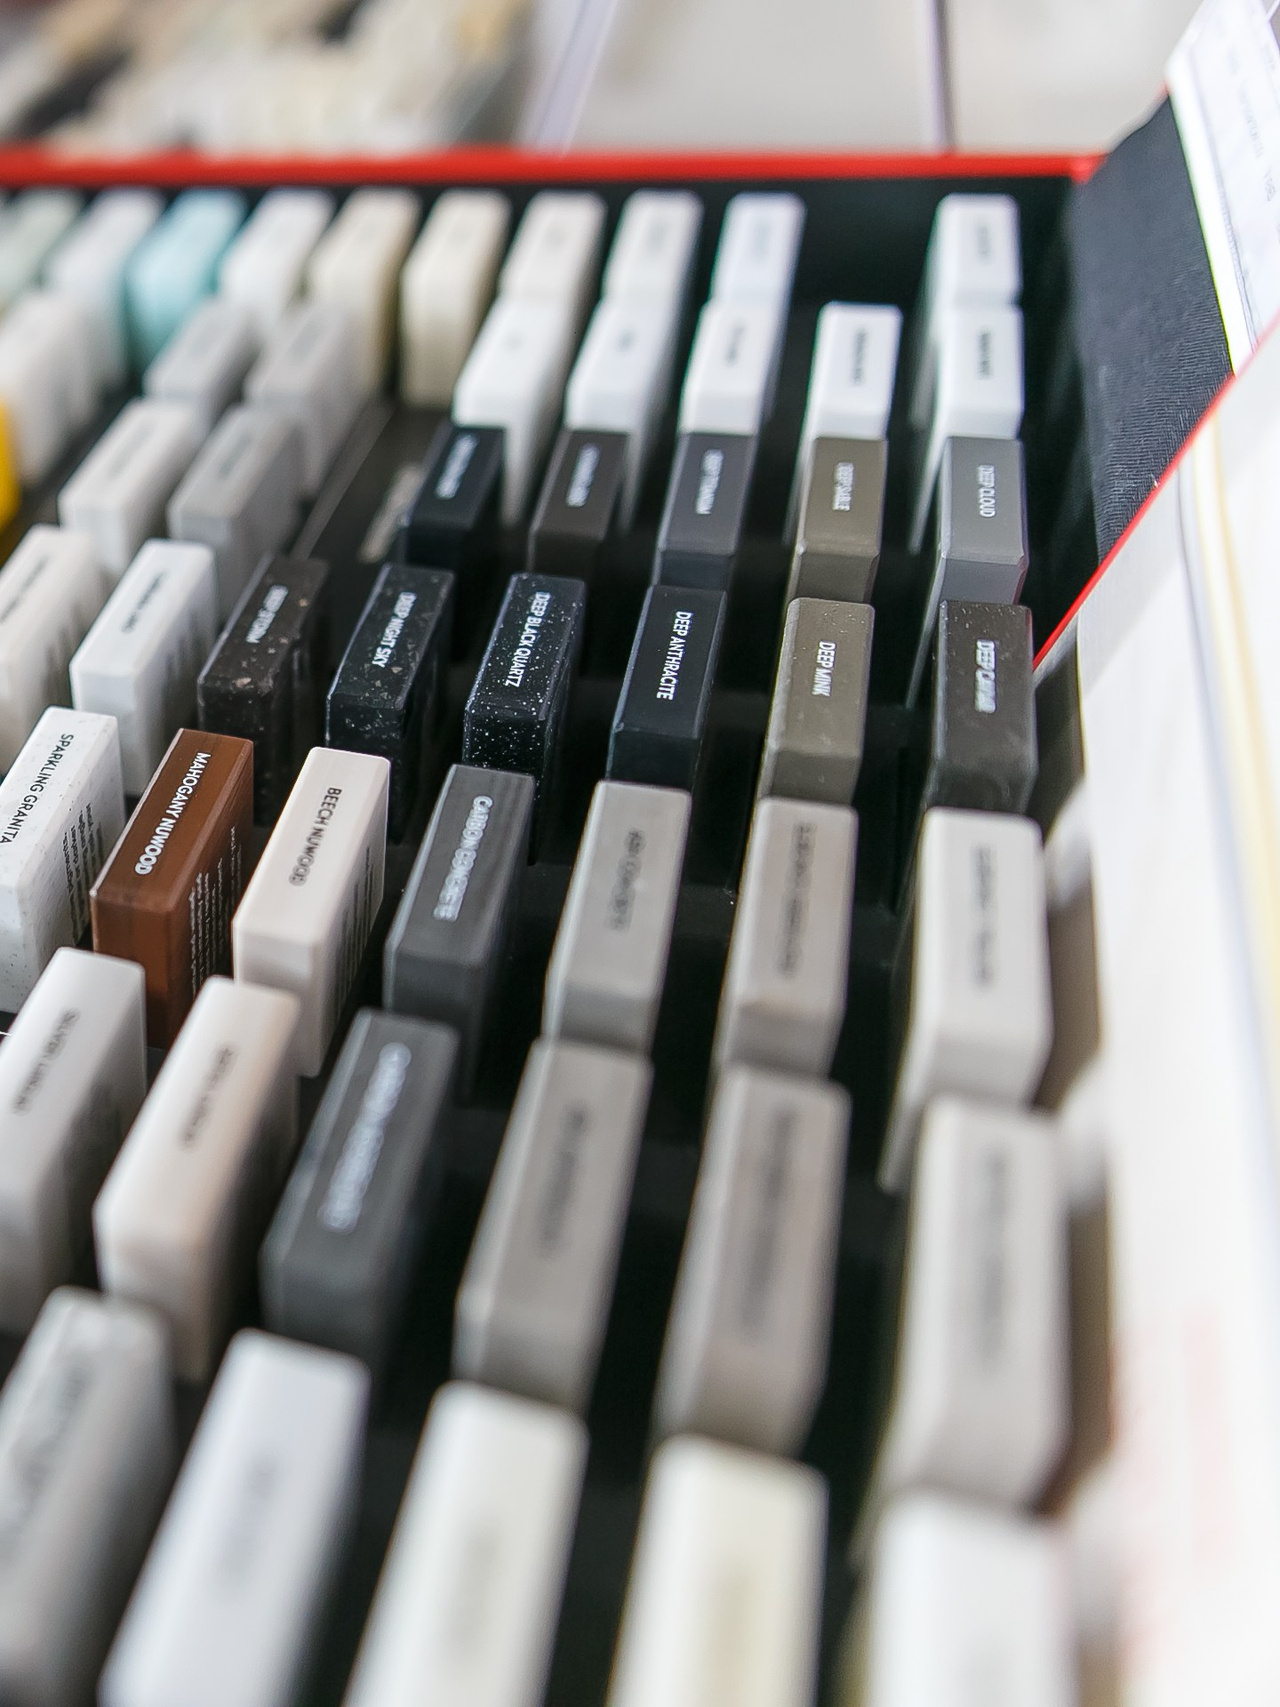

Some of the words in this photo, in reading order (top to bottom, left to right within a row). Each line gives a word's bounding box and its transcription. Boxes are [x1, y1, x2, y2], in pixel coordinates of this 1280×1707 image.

[976, 465, 995, 490] DEEP
[978, 488, 995, 518] CLOUD
[394, 592, 416, 618] DEEP
[530, 591, 551, 617] DEEP
[381, 616, 405, 650] NIGHT
[520, 615, 545, 646] BLACK
[672, 610, 693, 636] DEEP
[372, 647, 390, 668] SKY
[505, 644, 531, 688] QUARTZ
[657, 636, 687, 700] ANTHRACITE
[816, 641, 836, 668] DEEP
[975, 639, 996, 669] DEEP
[812, 667, 832, 697] MINK
[30, 733, 74, 799] SPARKLING
[166, 752, 211, 819] MAHOGANY
[318, 787, 342, 827] BEECH
[460, 795, 494, 850] CARBON
[135, 817, 176, 875] NUWOOD
[289, 827, 325, 887] NUWOOD
